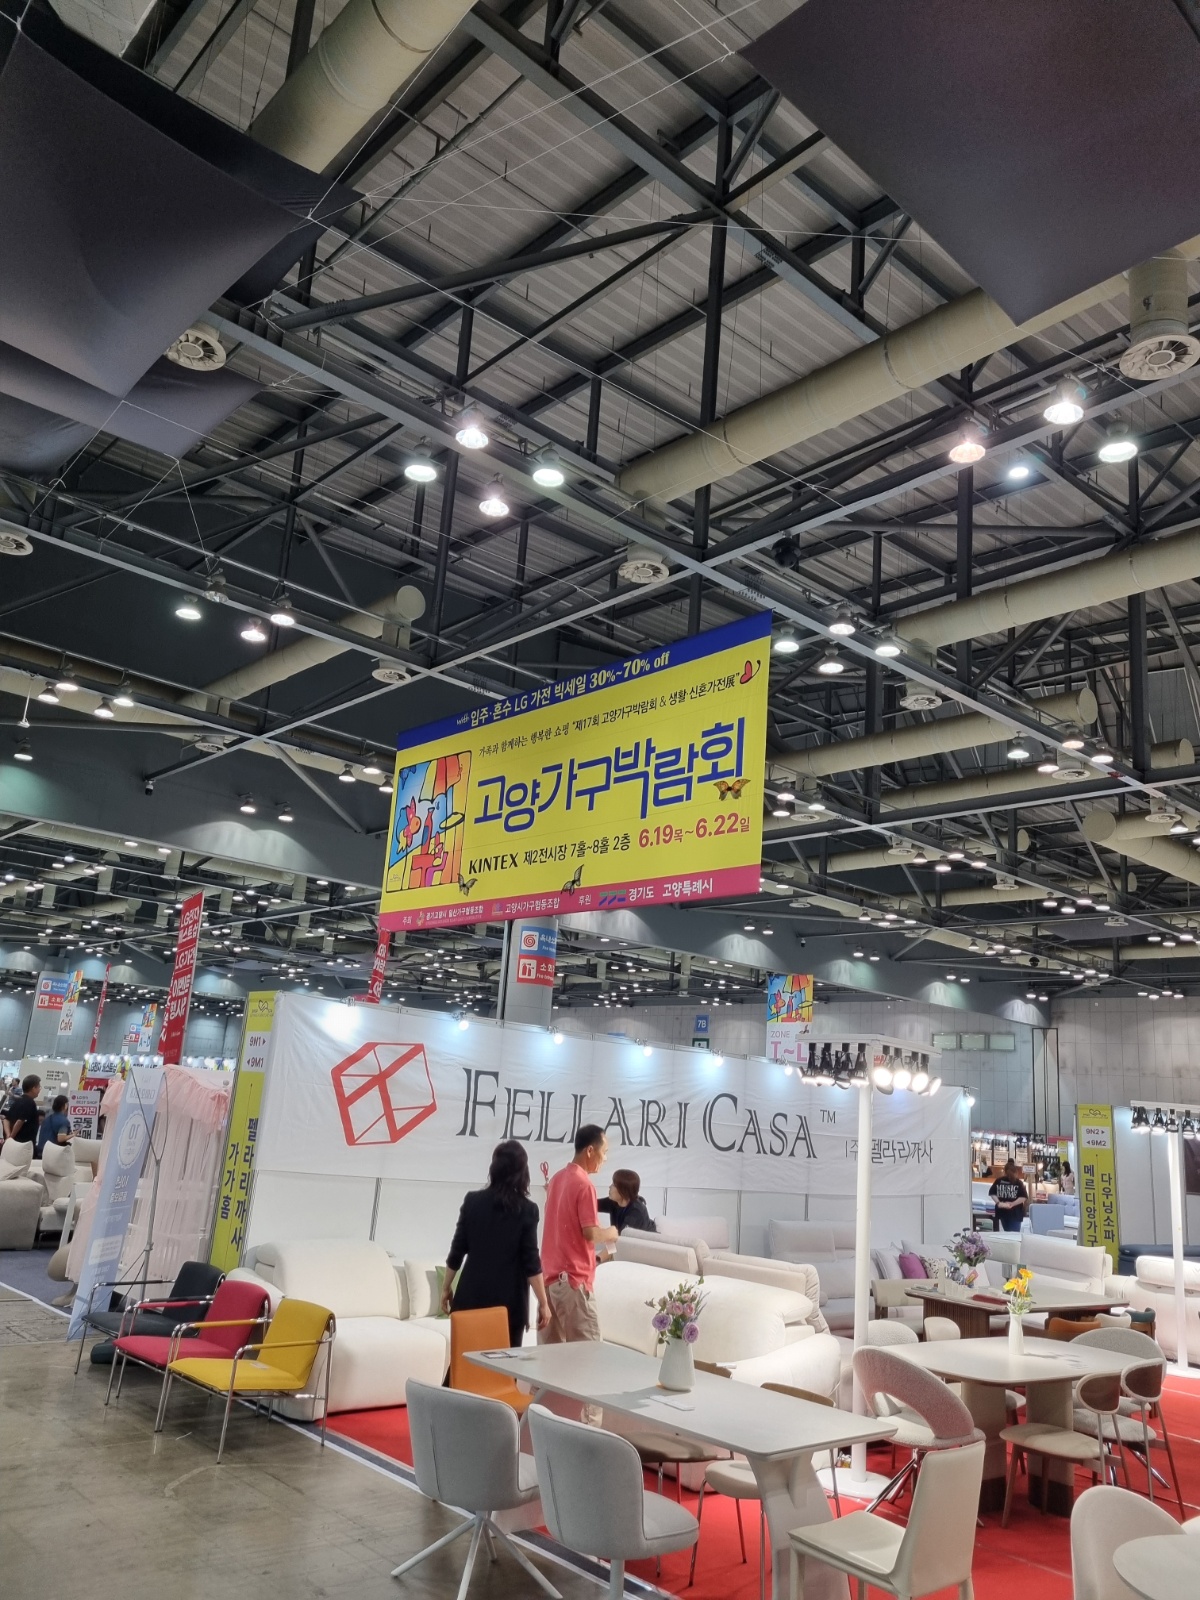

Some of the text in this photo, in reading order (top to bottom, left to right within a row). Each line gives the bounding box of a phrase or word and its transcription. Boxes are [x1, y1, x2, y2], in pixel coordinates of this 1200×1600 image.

[514, 695, 528, 712] LG
[530, 685, 552, 708] 가전
[554, 674, 587, 700] 빅세일
[653, 651, 670, 669] off
[479, 743, 499, 757] 가족과
[500, 735, 529, 753] 함께하는
[530, 727, 552, 744] 행복한
[554, 722, 570, 737] 쇼핑
[601, 698, 658, 725] 고양가구박람회
[659, 695, 667, 707] &
[473, 717, 746, 833] 고양가구박람회
[468, 852, 519, 875] KINTEX
[523, 844, 568, 866] 제2전시장
[570, 836, 610, 858] 7홀~8홀
[613, 833, 631, 851] 2층
[505, 897, 561, 914] 고양시가구협동조합
[578, 894, 592, 906] 후원
[628, 886, 655, 901] 경기도
[662, 878, 714, 898] 고양특례시
[697, 1019, 707, 1029] 7B
[770, 1030, 791, 1039] ZONE
[71, 1106, 97, 1115] LG가전
[702, 1092, 818, 1159] CASA
[220, 1142, 239, 1220] 가가홈
[231, 1118, 259, 1252] 펠라리까사
[1083, 1164, 1099, 1247] 메르디앙가구
[1101, 1173, 1116, 1243] 다우닝소파
